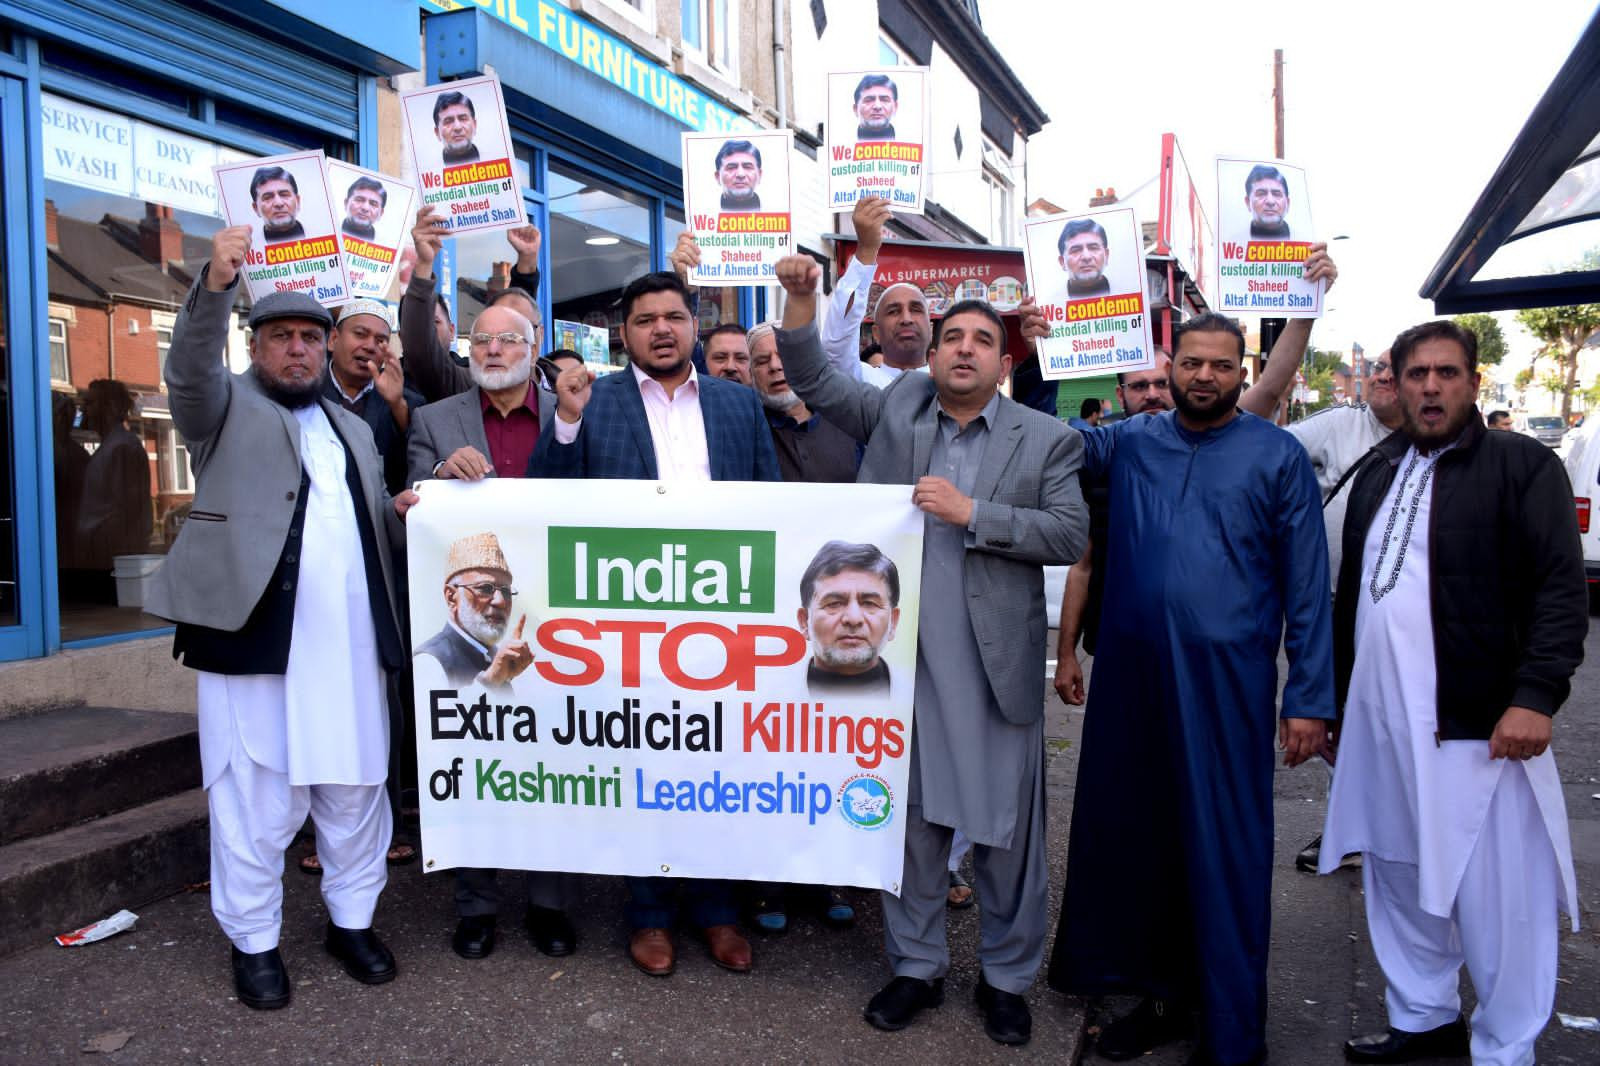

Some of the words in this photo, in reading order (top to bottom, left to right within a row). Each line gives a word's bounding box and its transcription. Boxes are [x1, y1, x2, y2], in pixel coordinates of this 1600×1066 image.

[537, 2, 700, 127] FURNITURE
[41, 105, 129, 146] SERVICE
[156, 140, 195, 165] DRY
[832, 145, 852, 161] We
[855, 143, 920, 161] condemn
[55, 147, 118, 181] WASH
[831, 161, 875, 176] custodial
[878, 161, 908, 176] killing
[910, 164, 920, 175] of
[135, 166, 217, 199] CLEANING
[421, 171, 441, 189] We
[444, 162, 509, 186] condemn
[856, 176, 896, 188] Shaheed
[424, 187, 467, 204] custodial
[469, 182, 500, 197] killing
[502, 179, 512, 191] of
[833, 190, 857, 204] Altaf
[894, 188, 916, 203] Shah
[450, 199, 491, 215] Shaheed
[457, 214, 490, 227] Ahmed
[491, 208, 516, 223] Shah
[693, 214, 715, 231] We
[719, 213, 787, 231] condemn
[344, 239, 393, 262] ondemn
[743, 234, 775, 249] killing
[778, 234, 788, 247] of
[1222, 242, 1244, 259] We
[245, 249, 264, 266] We
[266, 239, 336, 264] condemn
[721, 250, 762, 262] Shaheed
[248, 264, 292, 281] custodial
[293, 260, 327, 274] killing
[328, 255, 339, 268] of
[351, 256, 379, 273] killing
[380, 264, 390, 273] of
[696, 263, 721, 276] Altaf
[724, 263, 759, 276] Ahmed
[761, 263, 777, 276] Sh
[897, 265, 991, 281] SUPERMARKET
[1220, 263, 1268, 277] custodial
[1271, 263, 1303, 279] killing
[274, 276, 317, 291] Shaheed
[317, 284, 343, 300] Shah
[1247, 279, 1289, 292] Shaheed
[1040, 304, 1064, 321] We
[1067, 297, 1140, 320] condemn
[1224, 293, 1248, 307] Altaf
[1250, 293, 1285, 307] Ahmed
[1287, 294, 1313, 307] Shah
[1048, 321, 1092, 339] ustodial
[1094, 319, 1128, 333] killing
[1130, 315, 1142, 329] of
[1072, 336, 1115, 352] Shaheed
[1049, 355, 1075, 369] Altaf
[1077, 351, 1113, 367] Ahmed
[1115, 346, 1143, 362] Shah
[575, 542, 753, 605] India!
[534, 617, 807, 691] STOP
[429, 690, 538, 743] Extra
[551, 695, 723, 753] Judicial
[743, 702, 905, 769] Killings
[429, 757, 464, 801] of
[475, 758, 622, 808] Kashmiri
[635, 768, 832, 825] Leadership
